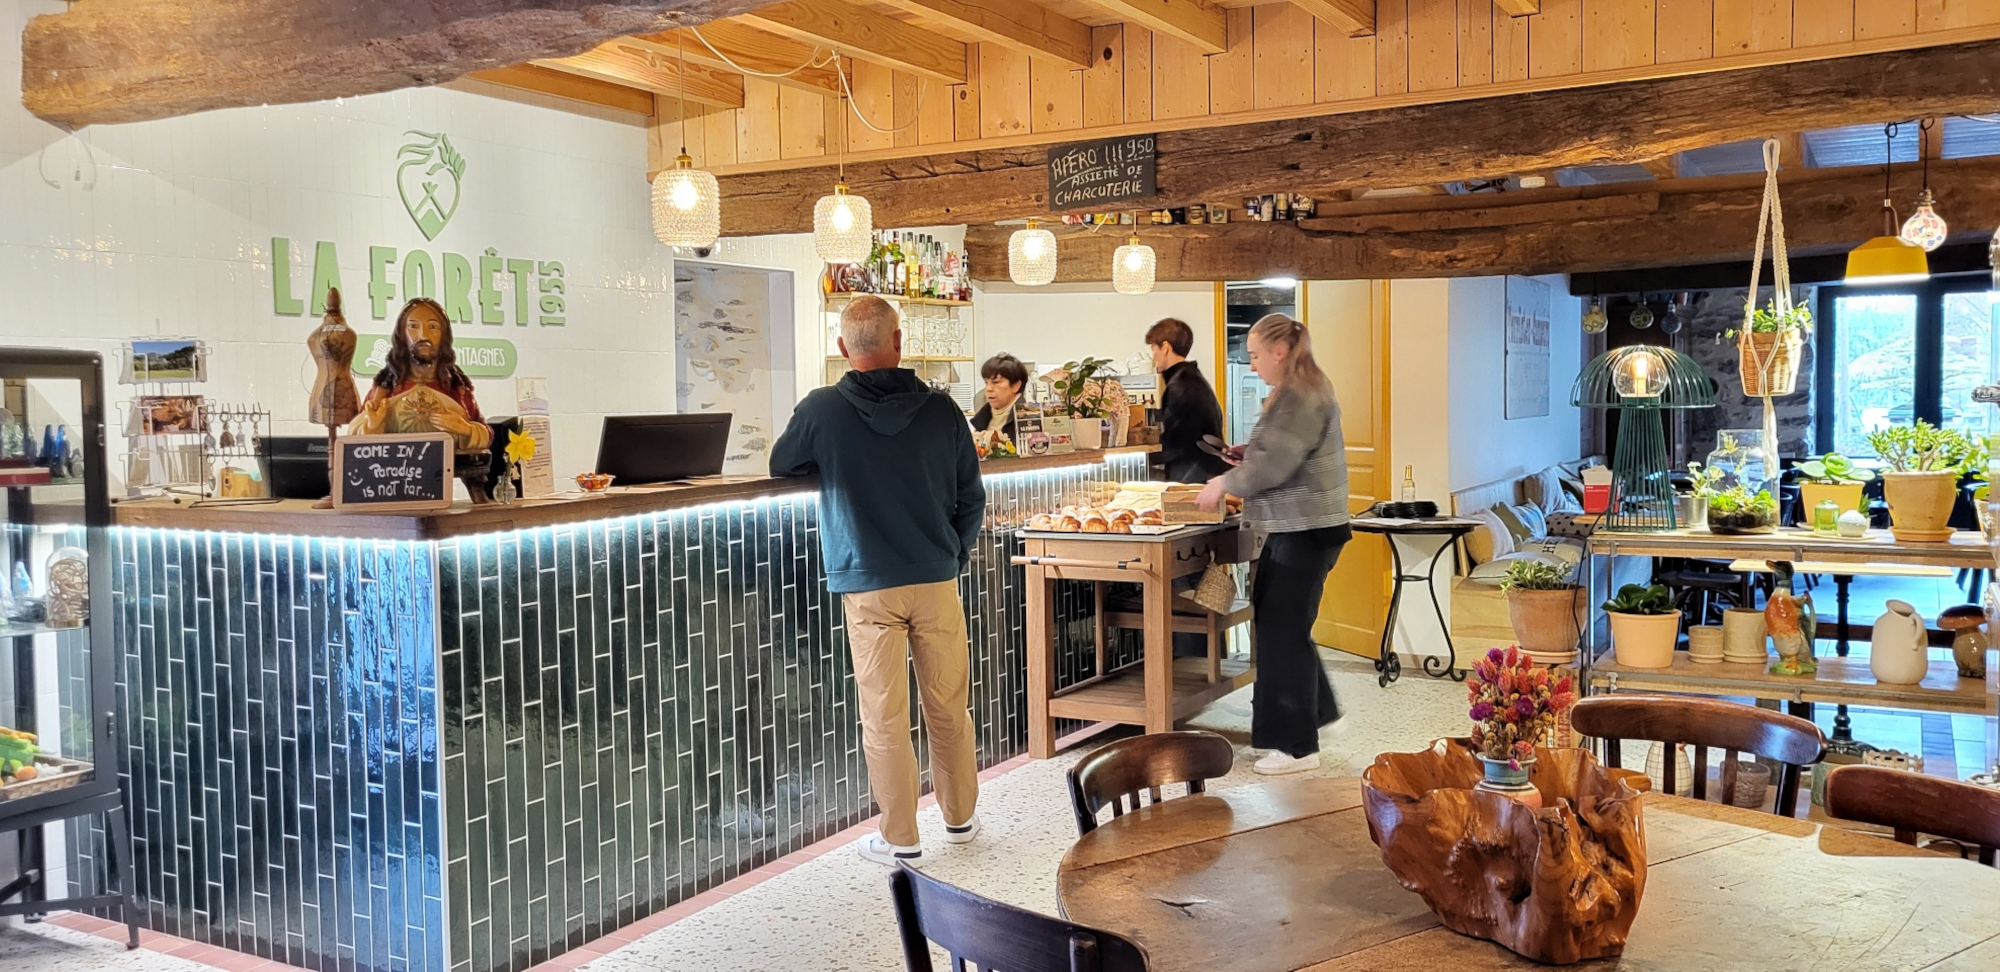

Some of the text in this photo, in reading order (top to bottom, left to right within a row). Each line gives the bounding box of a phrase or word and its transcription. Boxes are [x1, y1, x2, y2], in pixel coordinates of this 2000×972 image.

[1055, 180, 1142, 205] CHARCUTERIE
[272, 237, 534, 326] LA FORÊT
[538, 261, 566, 327] 1955
[353, 445, 390, 459] COME
[368, 459, 423, 479] Paradise
